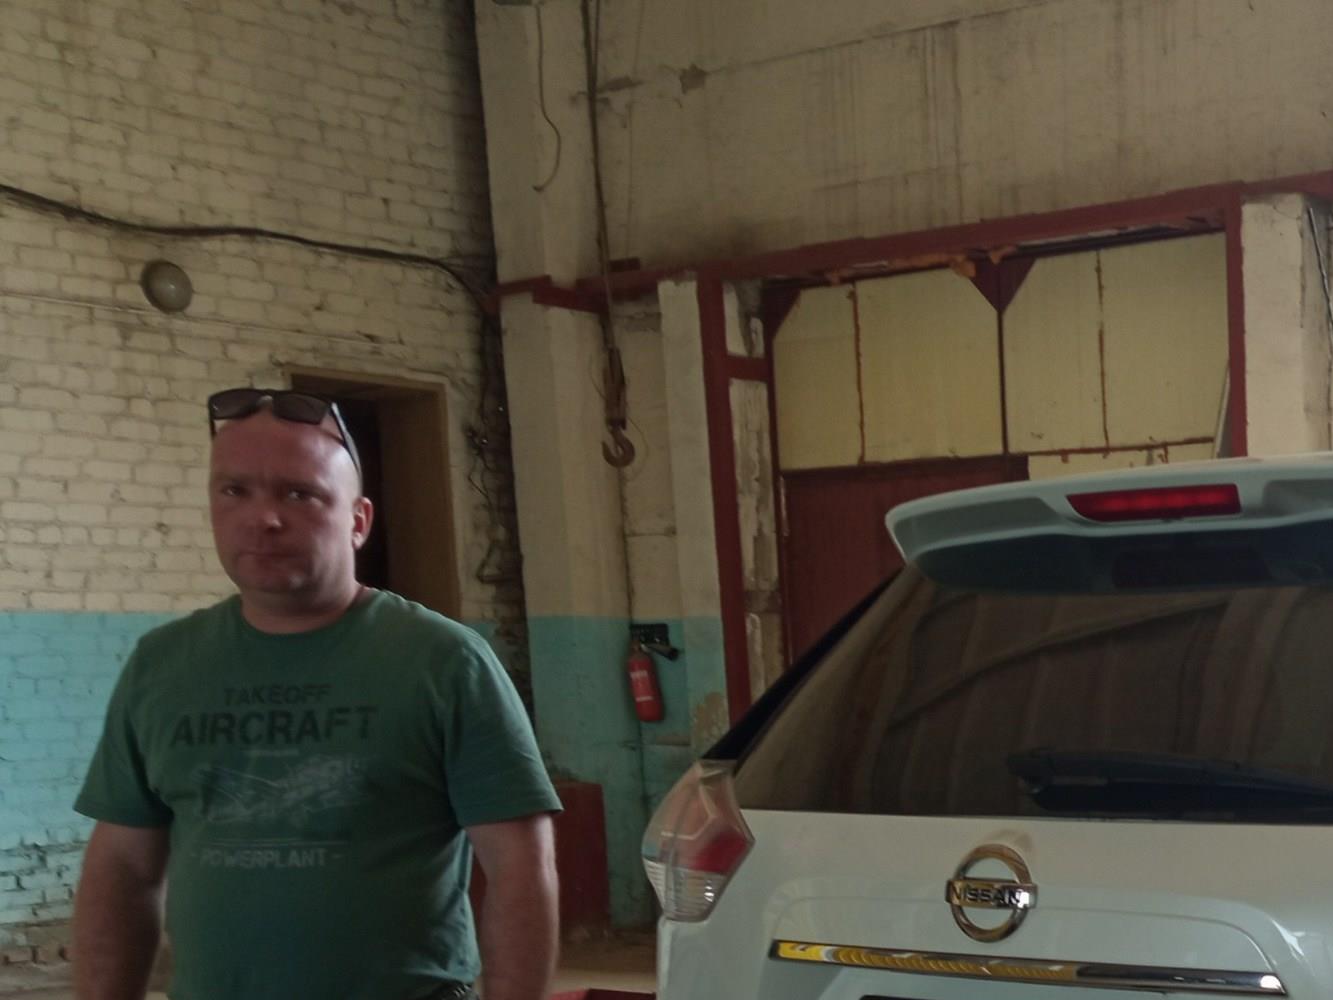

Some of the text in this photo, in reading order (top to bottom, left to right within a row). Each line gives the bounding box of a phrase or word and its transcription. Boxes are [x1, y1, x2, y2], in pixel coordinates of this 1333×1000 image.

[224, 683, 332, 706] TAKEOFF
[171, 705, 378, 747] AIRCRAFT
[200, 847, 328, 869] POWERPLANT
[951, 883, 1029, 908] NISSAN
